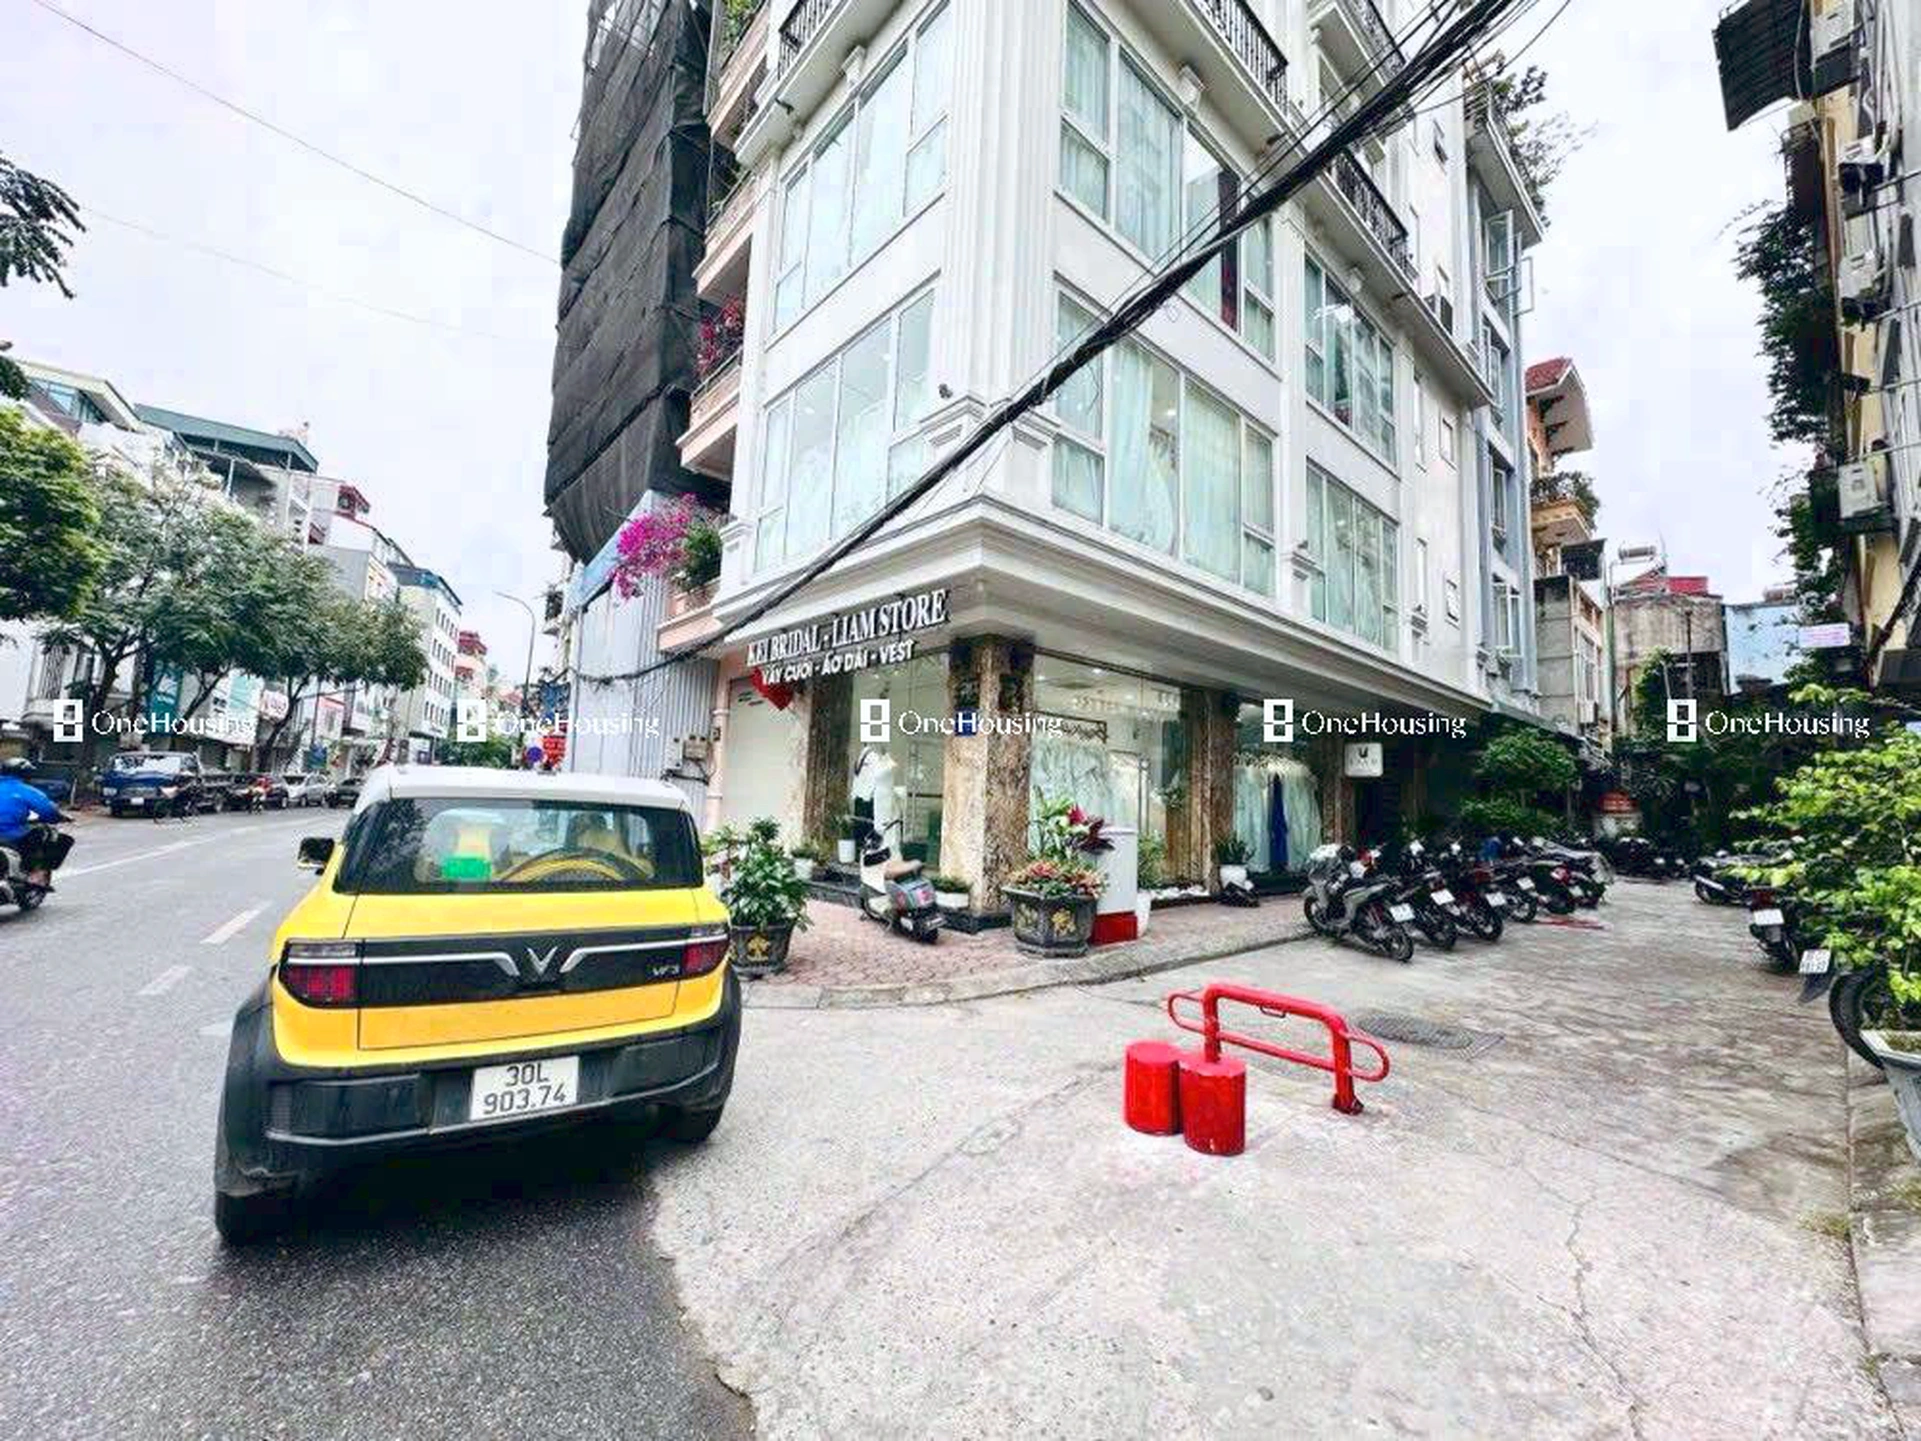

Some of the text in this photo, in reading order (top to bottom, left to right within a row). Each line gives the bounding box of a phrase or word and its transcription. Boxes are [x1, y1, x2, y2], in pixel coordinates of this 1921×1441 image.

[770, 624, 820, 660] BRIDAL
[832, 608, 876, 648] LIAM
[877, 588, 946, 636] STORE
[880, 638, 914, 664] VEST
[505, 1063, 549, 1087] 30L
[483, 1083, 566, 1115] 903.74
